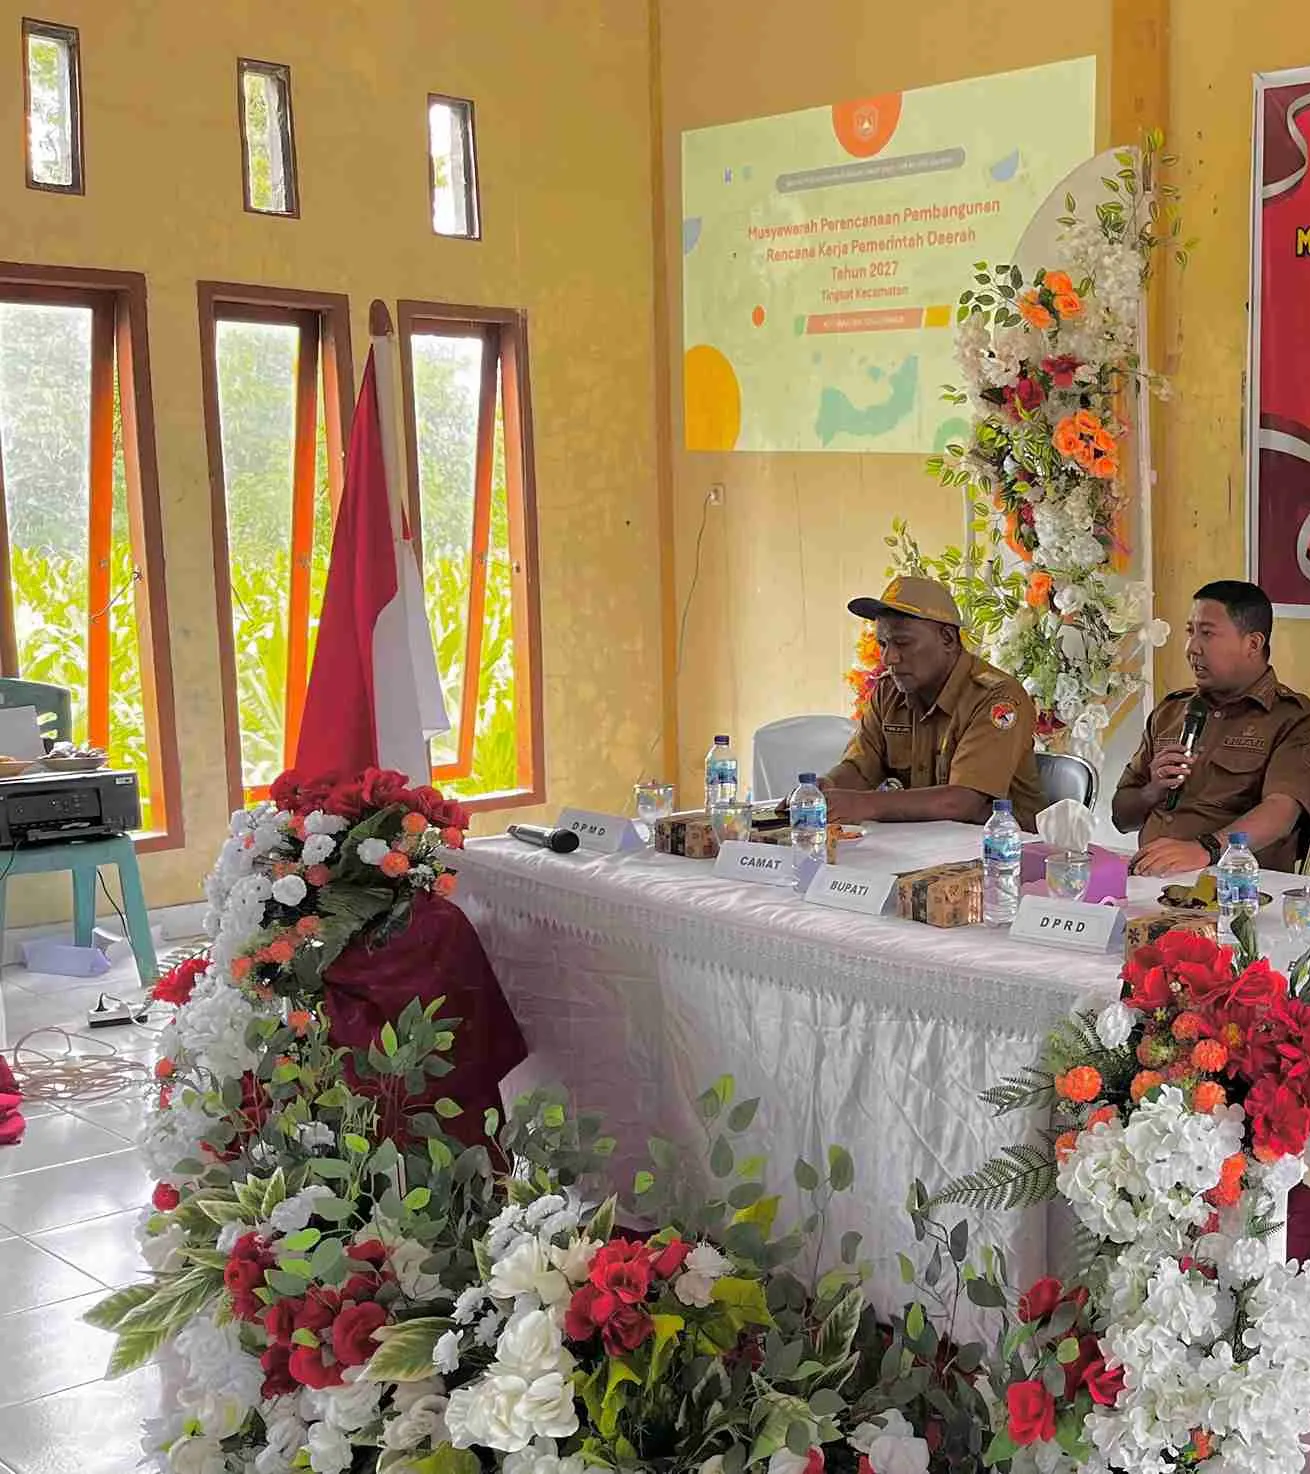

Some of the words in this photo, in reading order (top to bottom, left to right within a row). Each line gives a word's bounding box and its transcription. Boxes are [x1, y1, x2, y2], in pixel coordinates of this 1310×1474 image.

[748, 219, 819, 241] Musyawarah
[821, 212, 900, 232] Perencanaan
[904, 200, 1000, 222] Pembangunan
[767, 248, 816, 262] Rencana
[818, 242, 848, 260] Kerja
[852, 232, 924, 254] Pemerintah
[928, 227, 975, 246] Daerah
[830, 264, 867, 280] Tahun
[870, 261, 898, 278] 2027
[740, 856, 783, 870] CAMAT
[830, 880, 869, 897] BUPATI
[1040, 916, 1085, 933] DPRD
